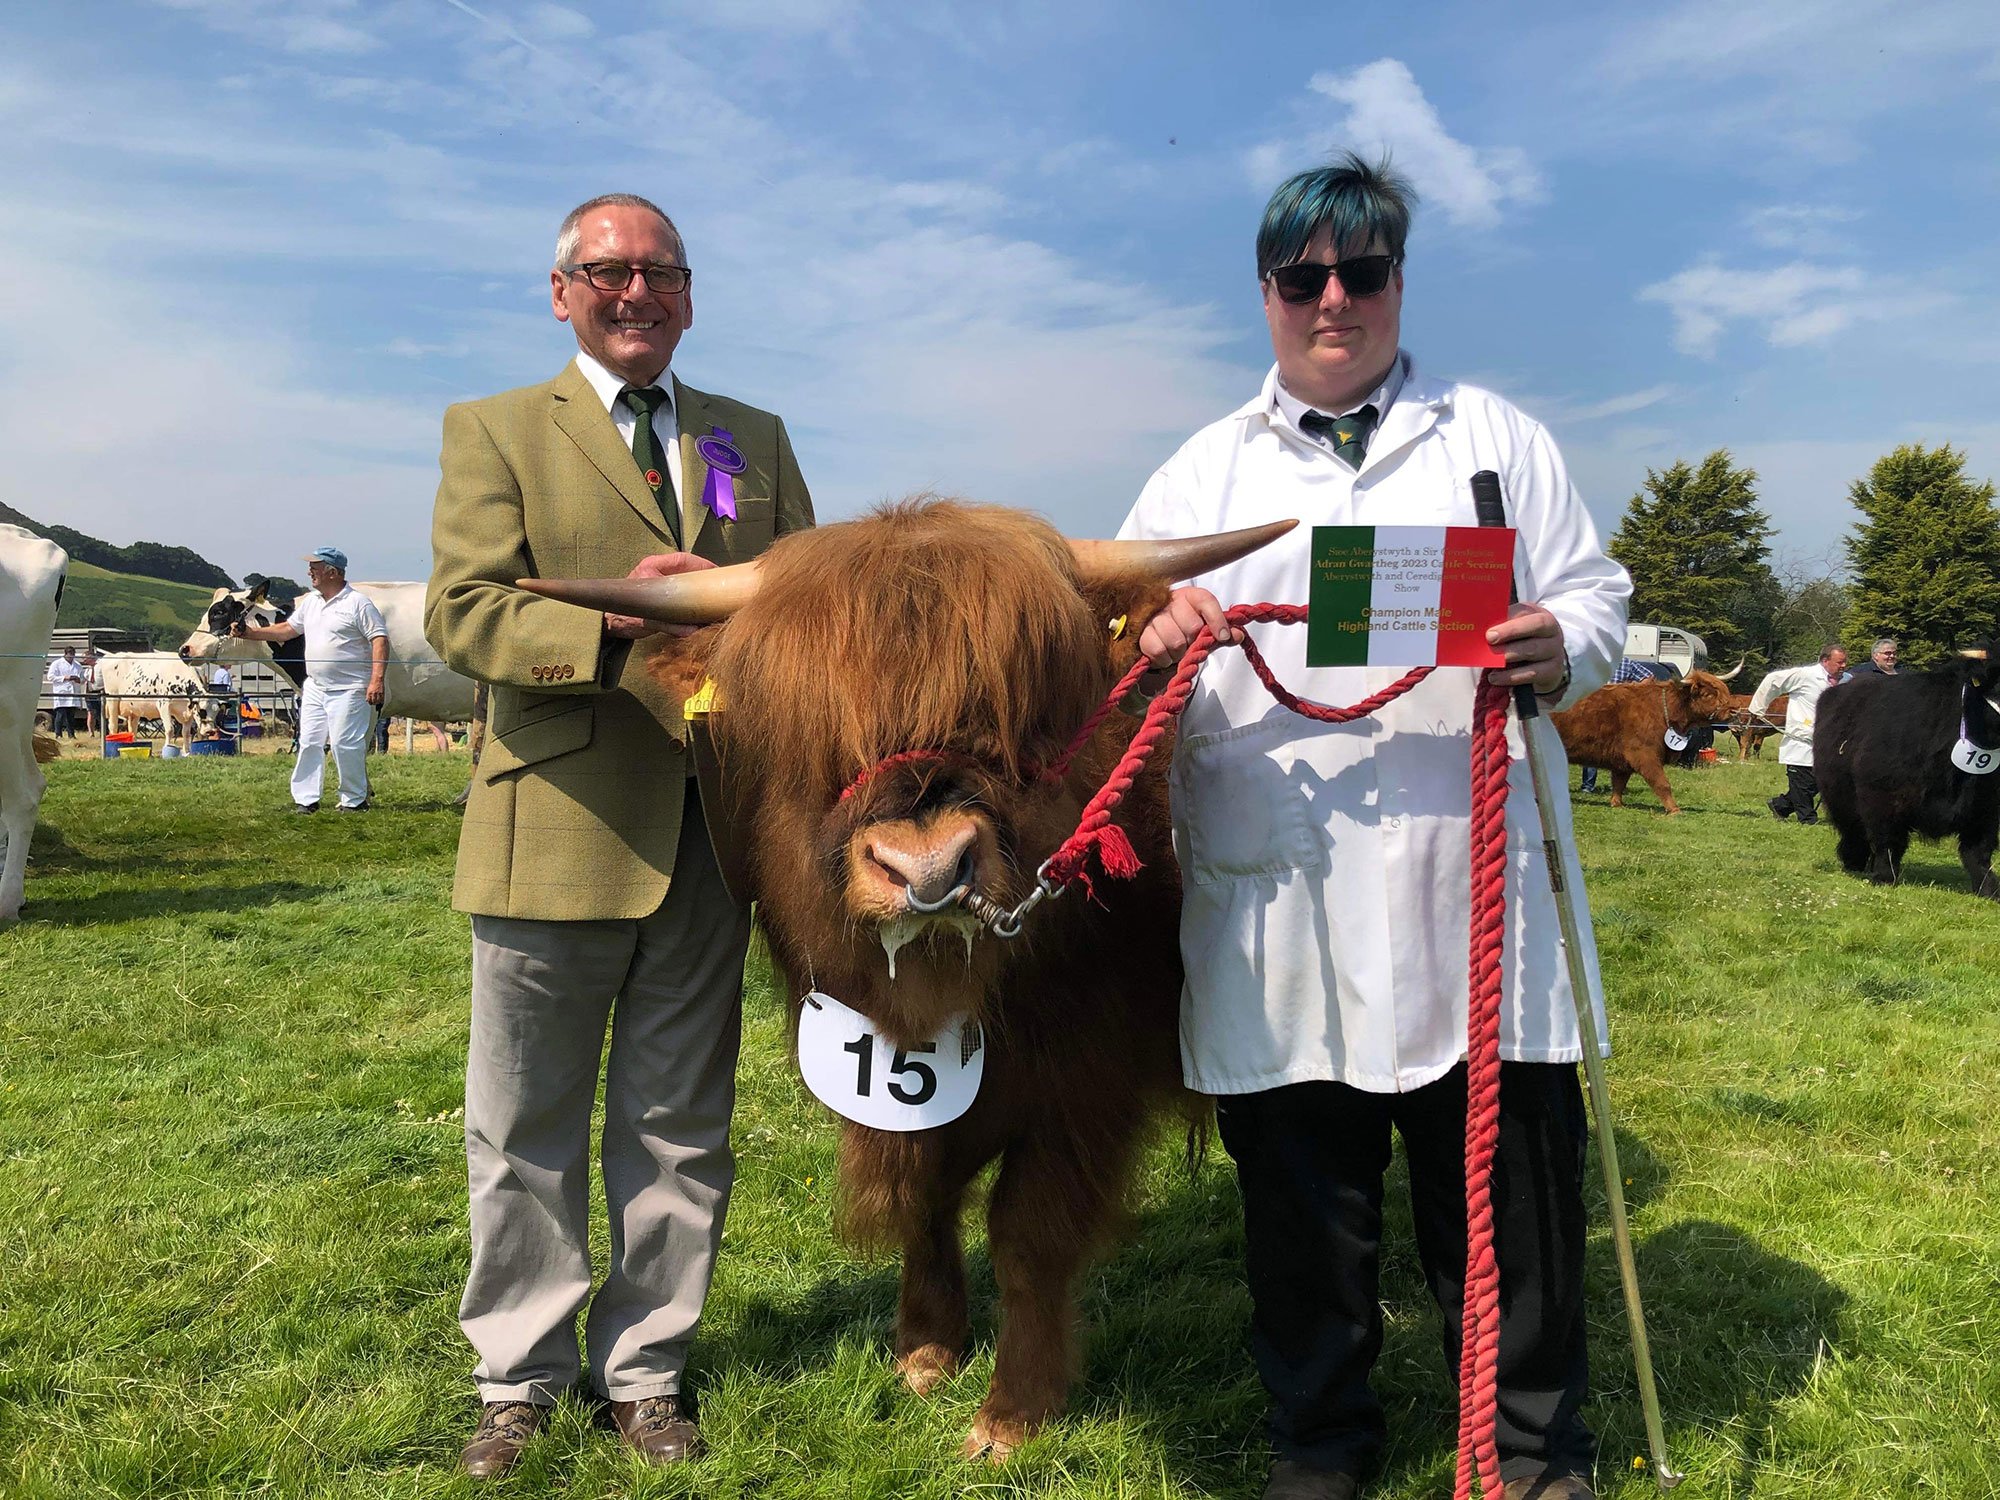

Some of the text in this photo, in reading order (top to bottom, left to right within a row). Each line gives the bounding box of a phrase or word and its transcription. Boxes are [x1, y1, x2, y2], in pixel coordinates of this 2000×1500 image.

[1350, 546, 1411, 557] Aberystwyth
[1423, 547, 1438, 556] Sir
[1315, 559, 1508, 569] Adran Gwartheg 2023 Cattle Section
[1323, 571, 1382, 582] Aberystwyth
[1385, 571, 1403, 580] and
[1394, 583, 1421, 593] Show
[1361, 607, 1453, 619] Champion Male
[1337, 621, 1475, 633] Highland Cattle Section
[1670, 735, 1682, 746] 17
[1966, 750, 1992, 769] 19
[844, 1033, 937, 1105] 15
